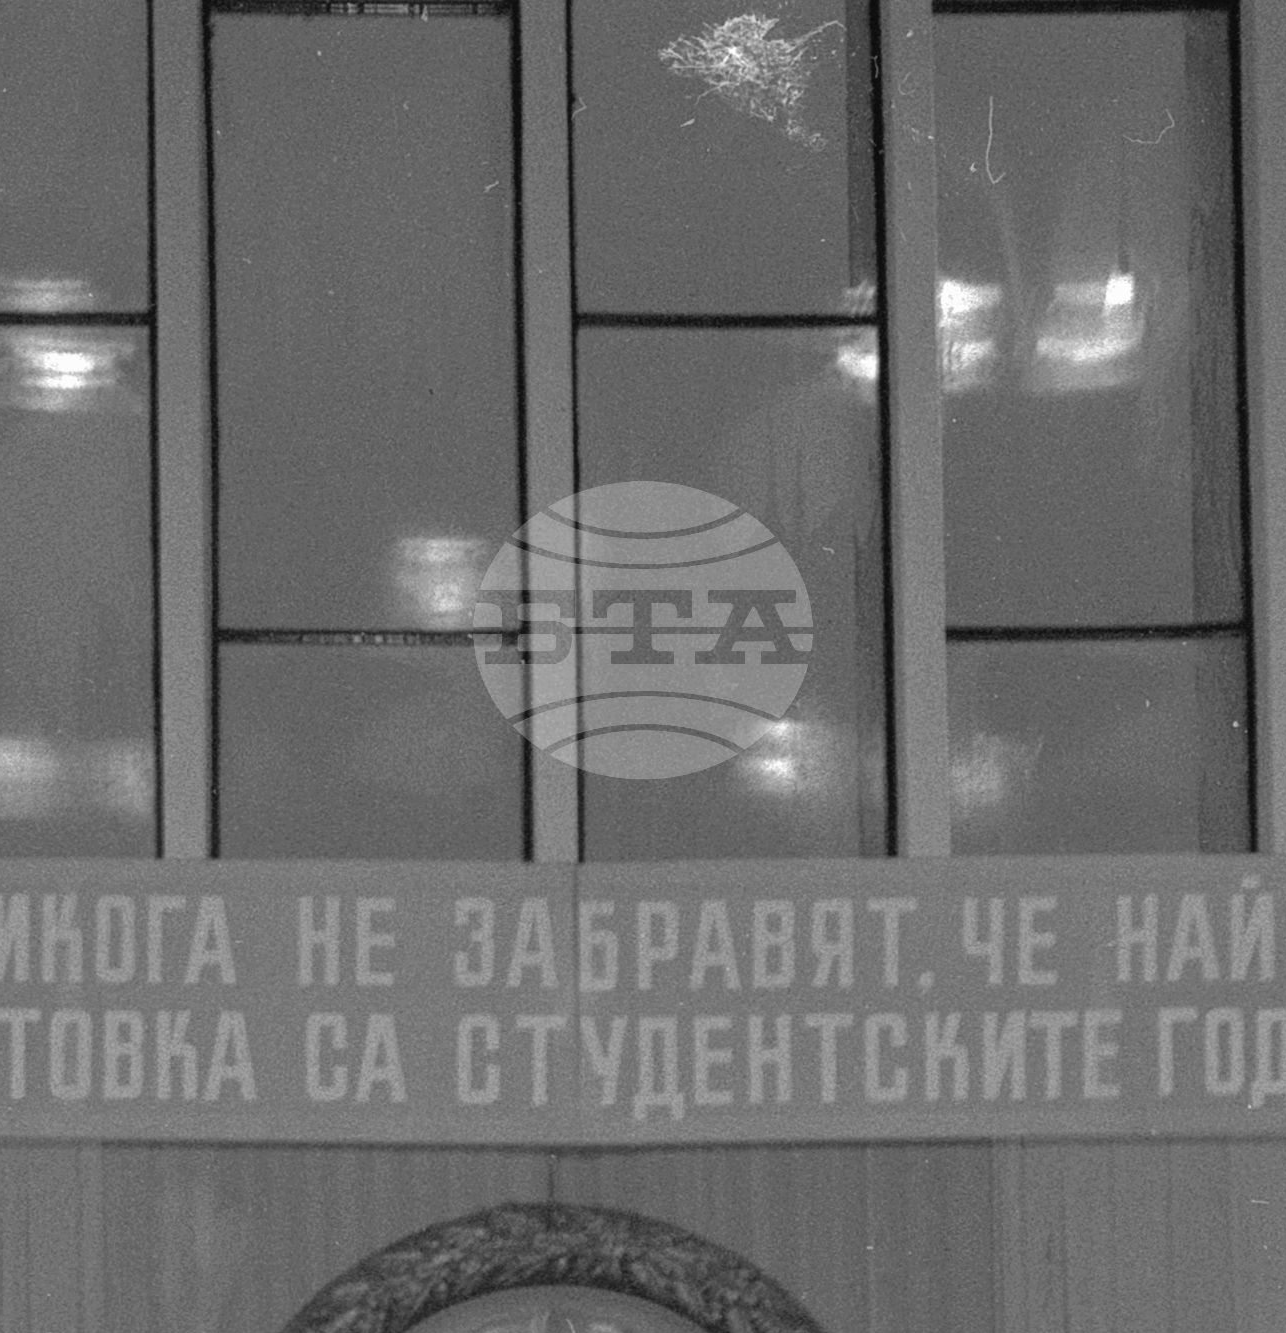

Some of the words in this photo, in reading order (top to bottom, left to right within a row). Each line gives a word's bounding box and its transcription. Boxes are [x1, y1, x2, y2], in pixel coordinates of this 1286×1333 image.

[297, 896, 397, 988] НЕ
[453, 896, 936, 993] ЗАБРАВЯТ,
[962, 896, 1058, 986] ЧЕ
[304, 1010, 408, 1104] СА
[455, 1007, 1123, 1121] СТУДЕНТСКИТЕ
